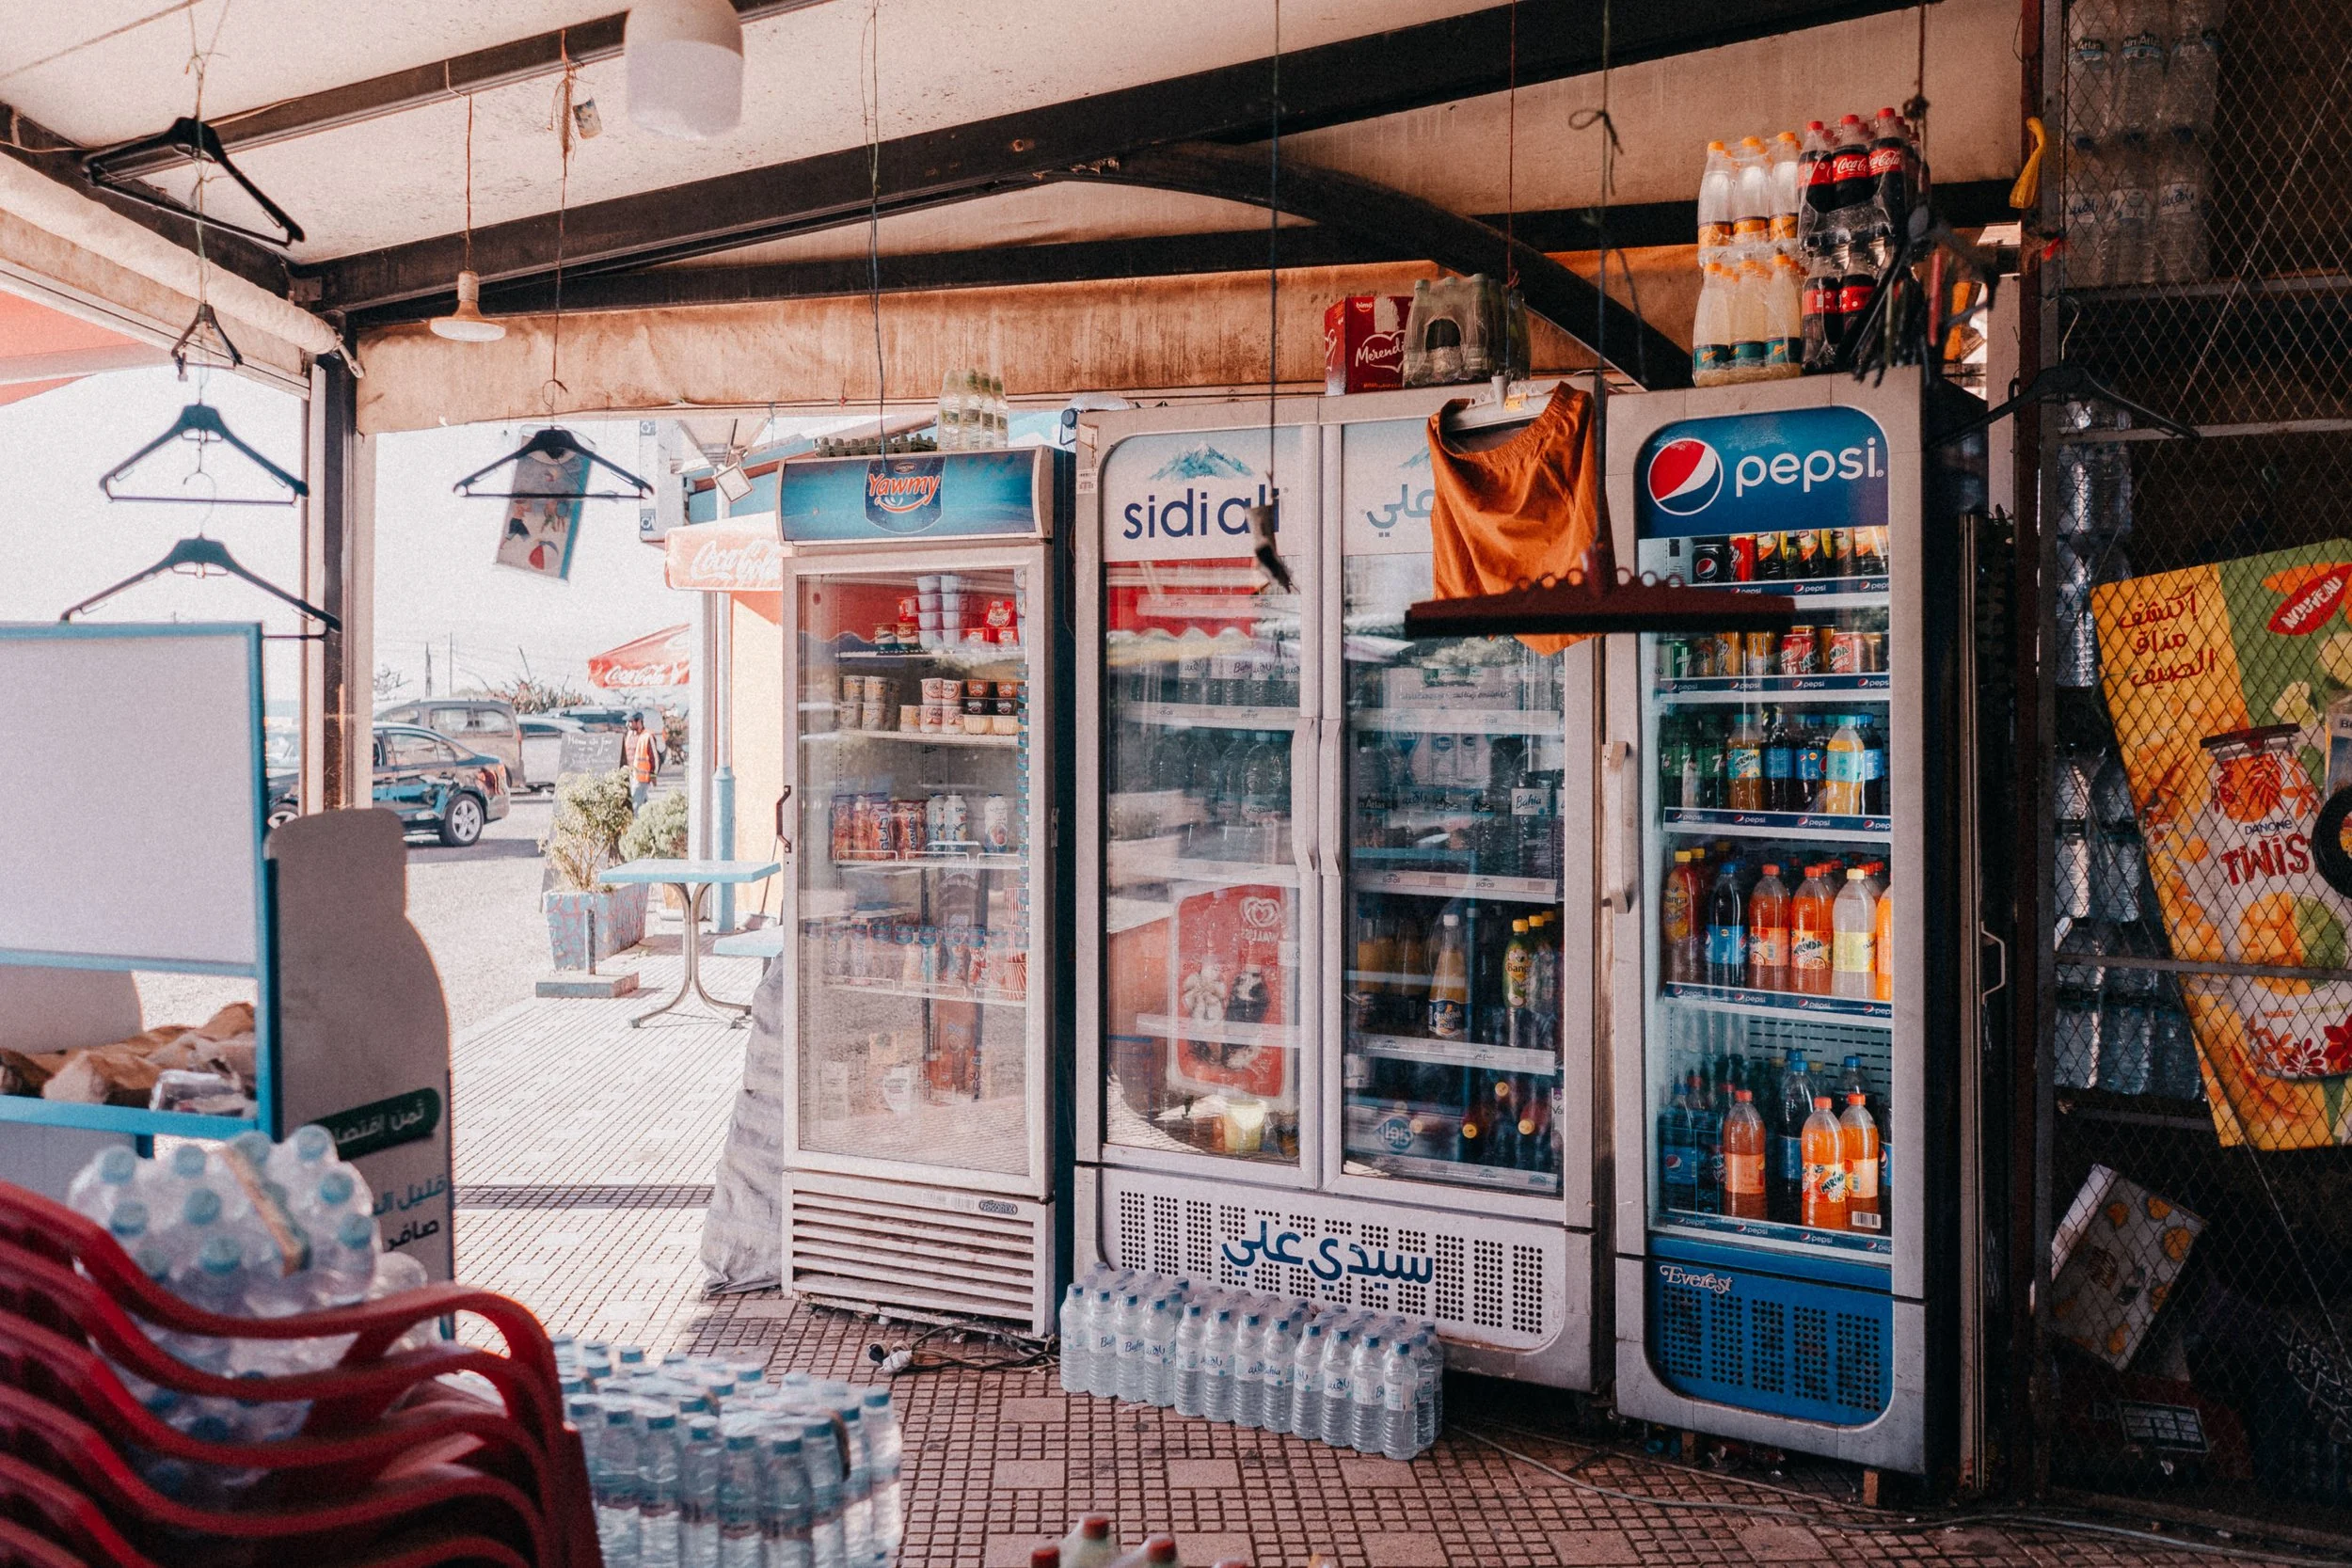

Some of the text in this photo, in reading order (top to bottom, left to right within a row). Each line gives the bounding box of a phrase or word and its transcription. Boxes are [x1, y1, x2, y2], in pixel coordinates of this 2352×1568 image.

[1868, 150, 1900, 169] oca-Cola
[1355, 337, 1406, 368] Merendi
[1735, 437, 1878, 498] pepsi
[867, 473, 941, 504] Yawmy
[1122, 487, 1208, 540] sidi
[1804, 584, 1827, 594] pepsi
[2280, 577, 2343, 629] NOUVEAU
[1739, 680, 1761, 690] pepsi
[1803, 679, 1825, 689] pepsi
[1868, 677, 1889, 689] peps
[1516, 795, 1542, 810] Bahia
[1682, 813, 1704, 822] pepsi
[1744, 816, 1766, 825] pepsi
[1808, 818, 1831, 828] pepsi
[1875, 821, 1891, 831] pep
[1744, 994, 1766, 1004] pepsi
[1874, 1006, 1892, 1016] pep
[334, 1114, 385, 1146] إقتصا
[1820, 1172, 1846, 1194] MIRIND
[1746, 1226, 1769, 1236] pepsi
[1811, 1234, 1834, 1244] pepsi
[1877, 1243, 1892, 1253] pep
[1220, 1219, 1434, 1292] سيدي علي
[1660, 1263, 1734, 1294] Everest
